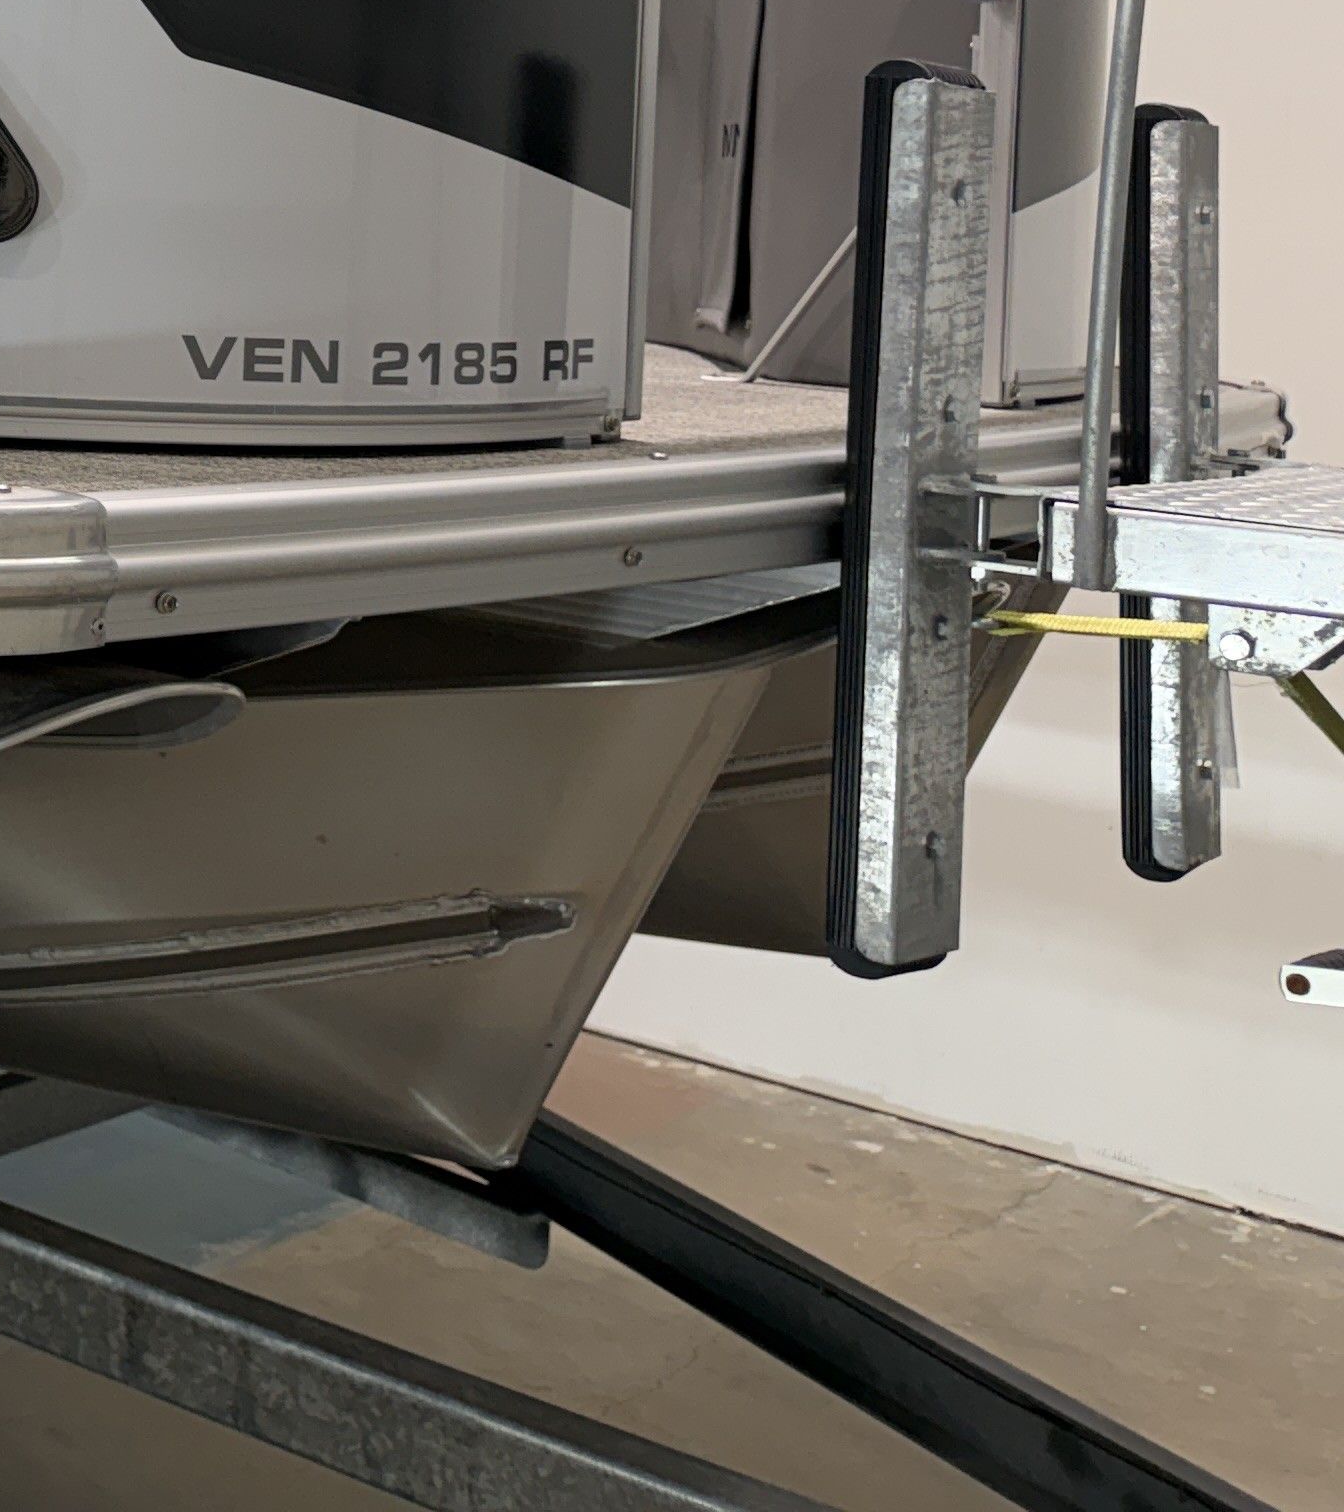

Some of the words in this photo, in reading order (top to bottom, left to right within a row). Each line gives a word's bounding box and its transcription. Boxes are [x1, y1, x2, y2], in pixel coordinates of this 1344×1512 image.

[181, 335, 340, 384] VEN
[372, 342, 518, 386] 2185
[542, 338, 595, 382] RF
